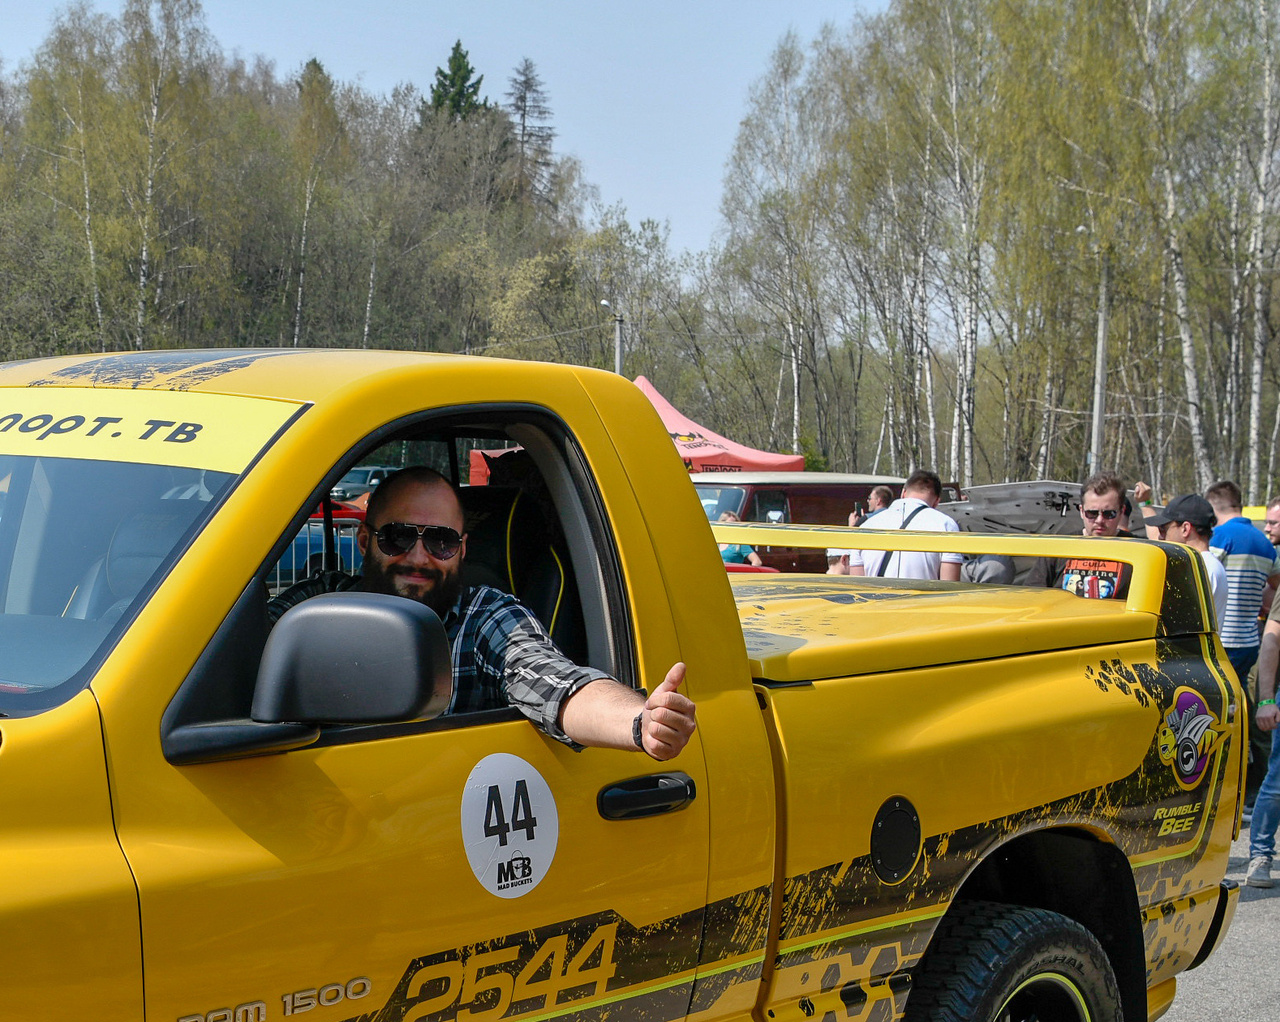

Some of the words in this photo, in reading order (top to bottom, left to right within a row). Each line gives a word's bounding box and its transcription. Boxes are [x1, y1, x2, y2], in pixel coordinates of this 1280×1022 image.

[484, 779, 537, 847] 44
[1153, 802, 1201, 820] RUMBLE
[1157, 816, 1195, 837] BEE
[497, 883, 510, 891] MAD
[510, 878, 533, 888] BUCKETS
[283, 976, 372, 1017] 1500
